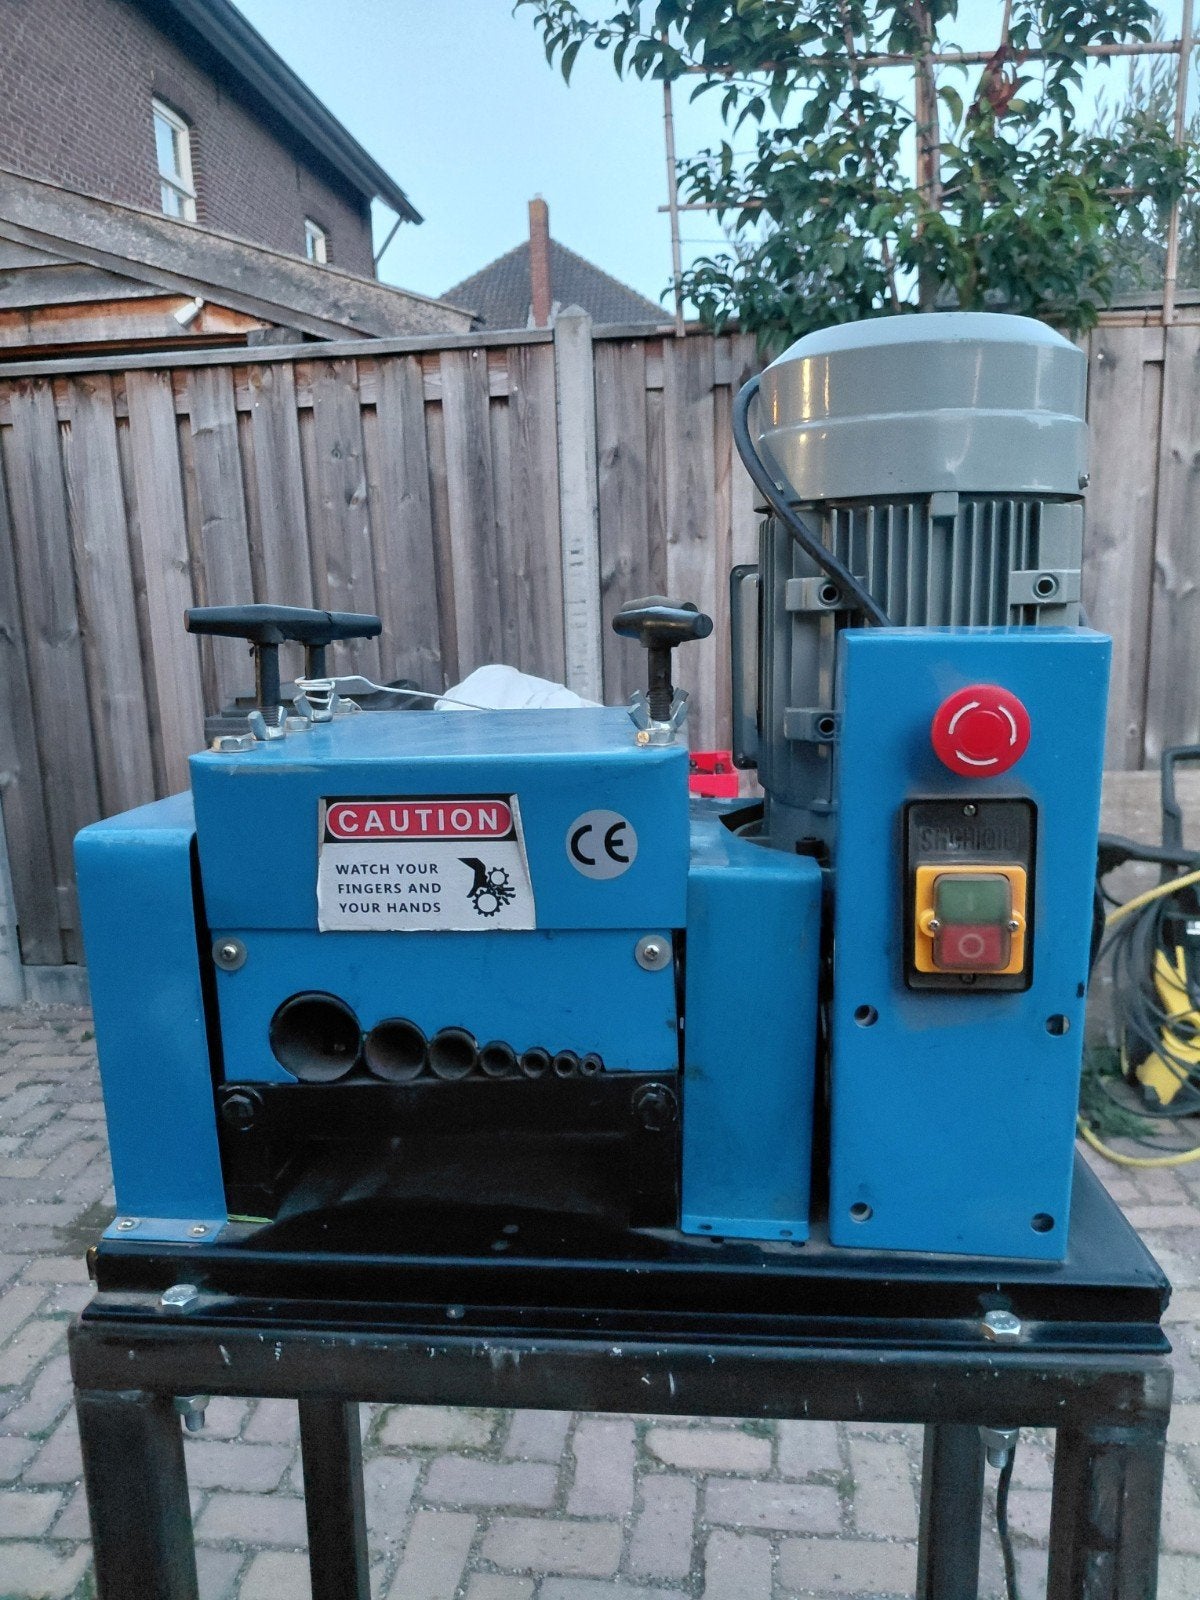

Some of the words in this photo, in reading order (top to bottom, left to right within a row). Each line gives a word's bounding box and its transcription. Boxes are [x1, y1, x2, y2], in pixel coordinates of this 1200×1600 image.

[338, 807, 498, 832] CAUTION
[570, 821, 630, 865] CE
[335, 863, 390, 875] WATCH
[396, 863, 439, 875] YOUR
[337, 883, 402, 894] FINGERS
[408, 883, 442, 893] AND
[339, 902, 381, 913] YOUR
[387, 902, 441, 913] HANDS
